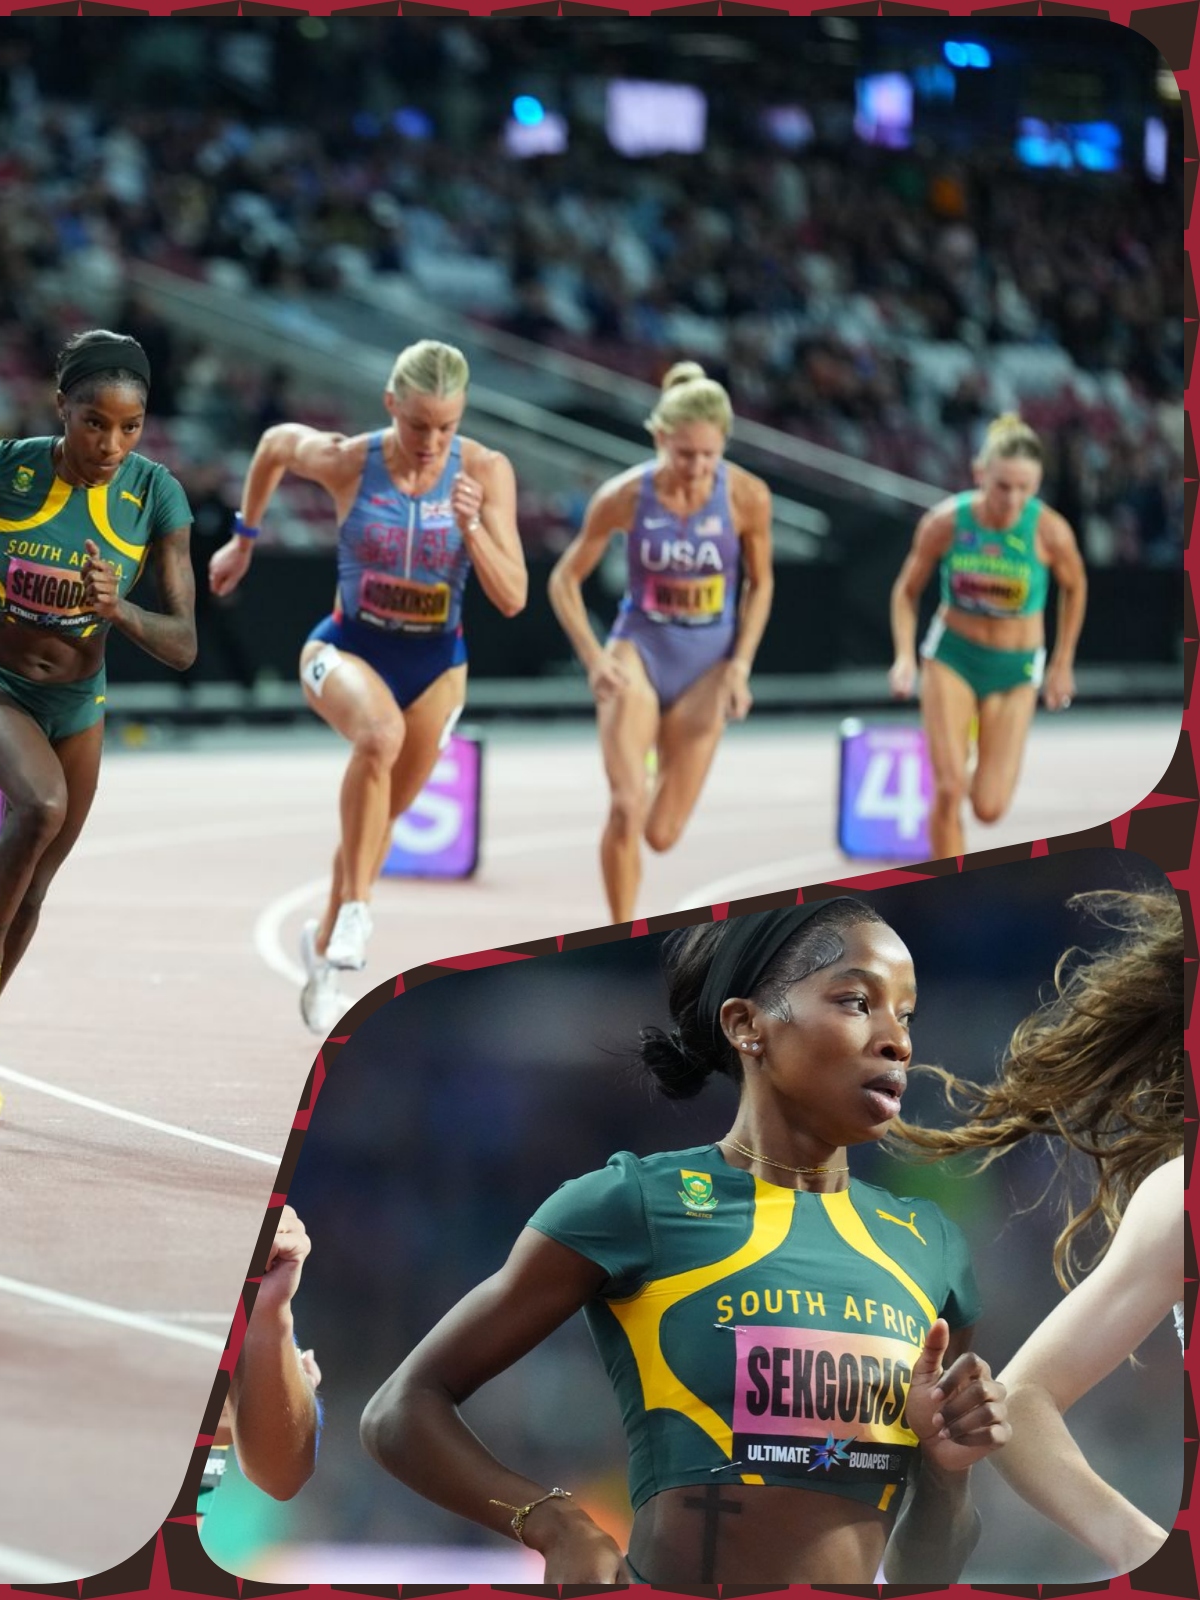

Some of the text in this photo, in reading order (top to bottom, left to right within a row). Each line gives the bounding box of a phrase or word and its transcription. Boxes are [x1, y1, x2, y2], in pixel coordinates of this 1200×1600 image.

[8, 539, 62, 562] SOUTH
[640, 538, 723, 572] USA
[853, 751, 930, 841] 4
[716, 1288, 826, 1323] SOUTH
[745, 1345, 912, 1431] SEKGODIS
[747, 1443, 811, 1464] ULTIMATE
[849, 1451, 890, 1470] BUDAPEST
